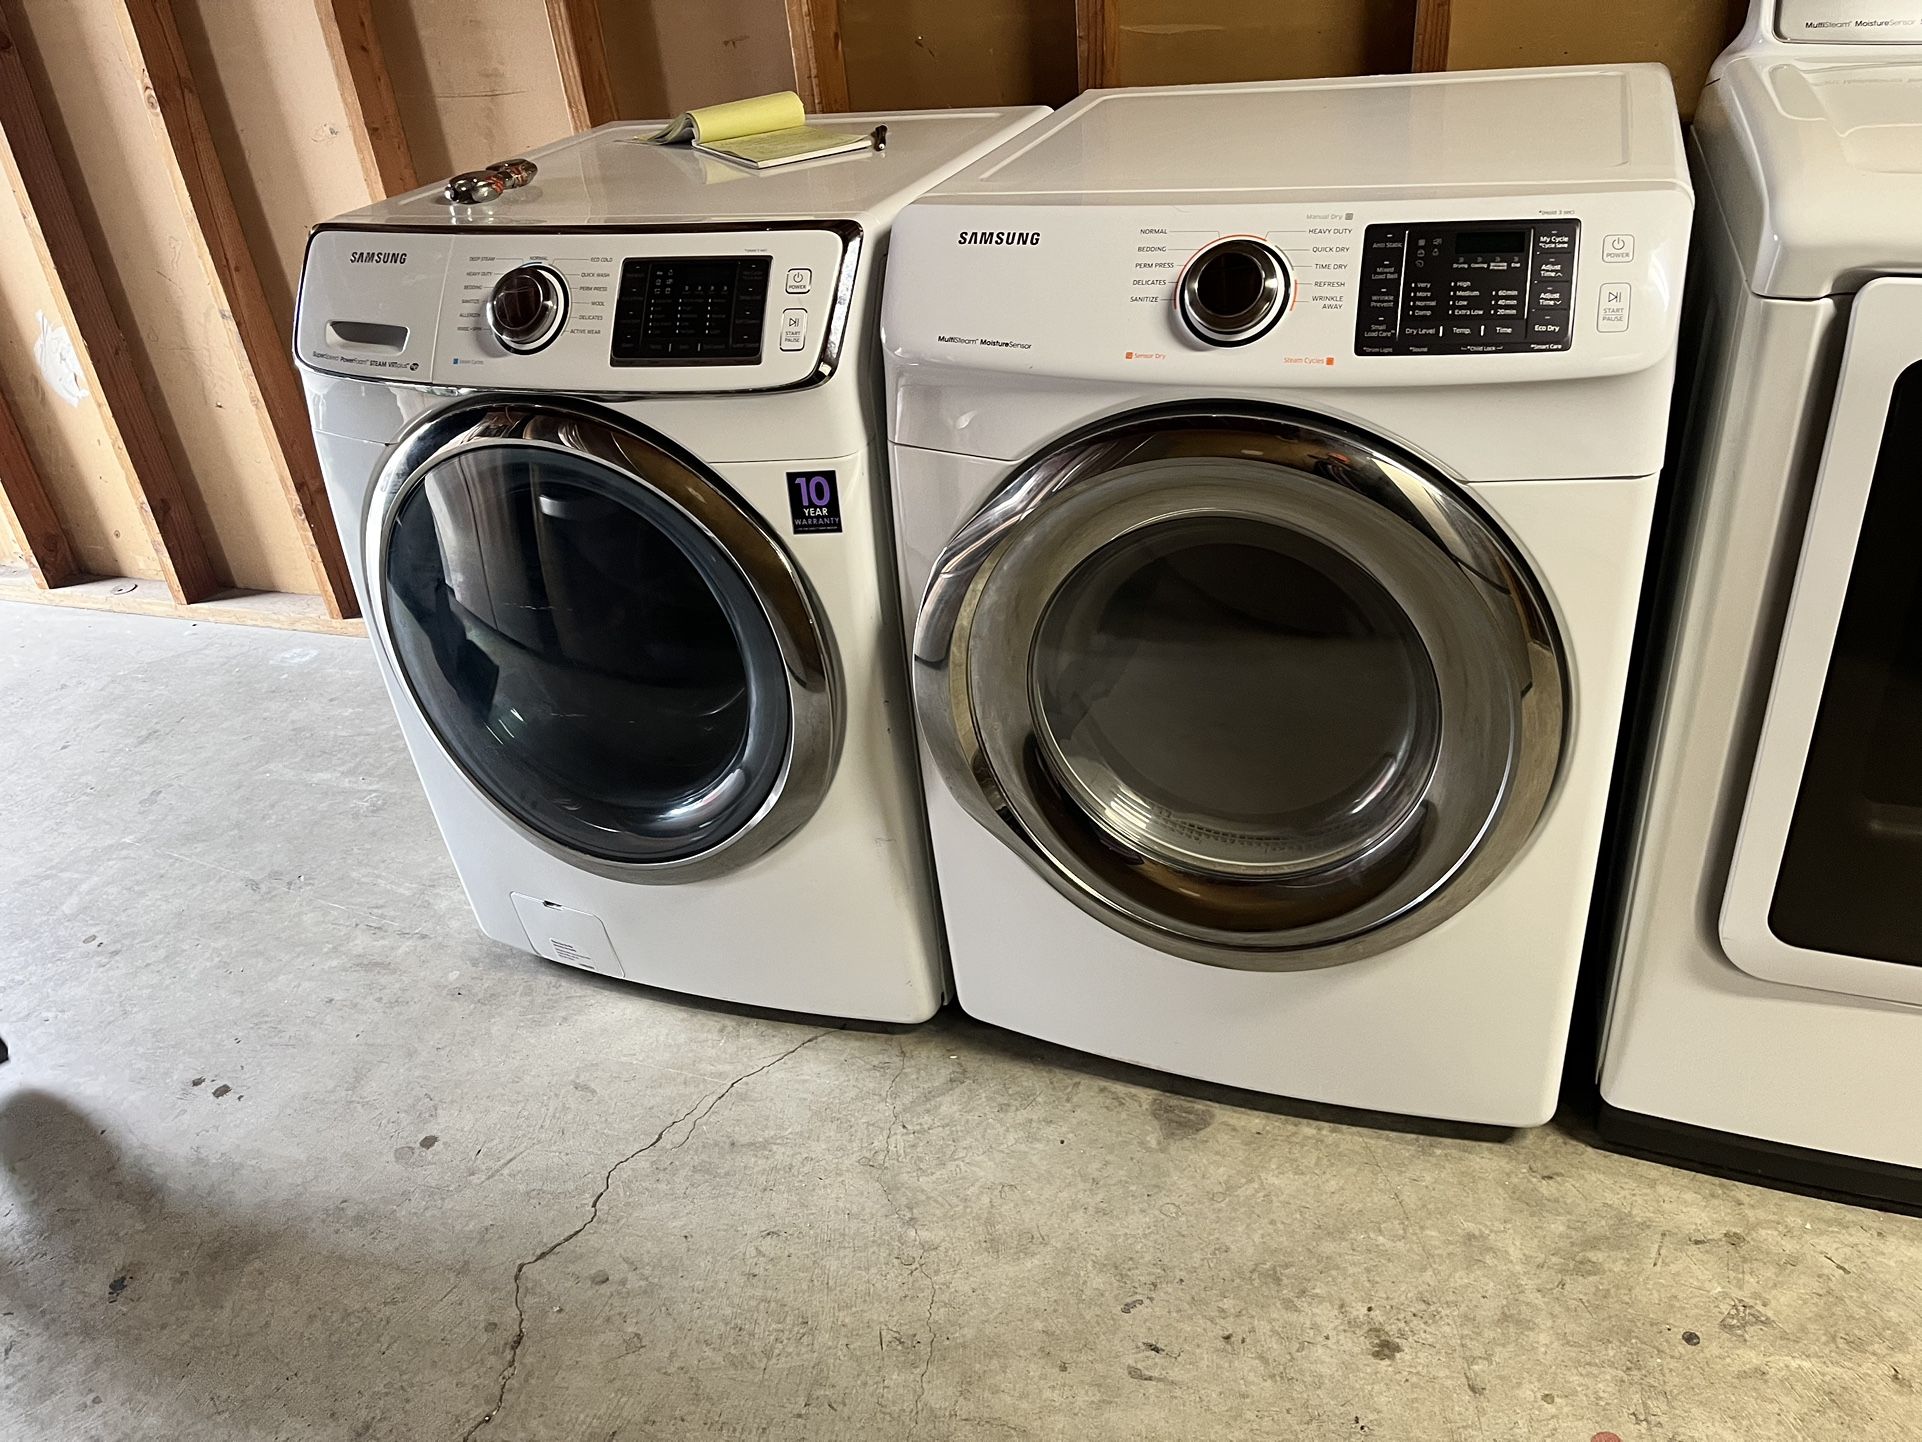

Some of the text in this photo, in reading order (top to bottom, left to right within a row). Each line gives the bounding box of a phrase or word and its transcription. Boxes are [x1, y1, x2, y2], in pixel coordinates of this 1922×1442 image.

[958, 232, 1041, 245] SAMSUNG
[350, 252, 407, 264] SAMSUNG
[1452, 327, 1471, 335] Temp.
[1547, 325, 1560, 333] Dry
[980, 338, 1032, 349] MoistureSensor
[1304, 357, 1325, 365] Cycles
[795, 476, 830, 506] 10
[803, 508, 828, 516] YEAR
